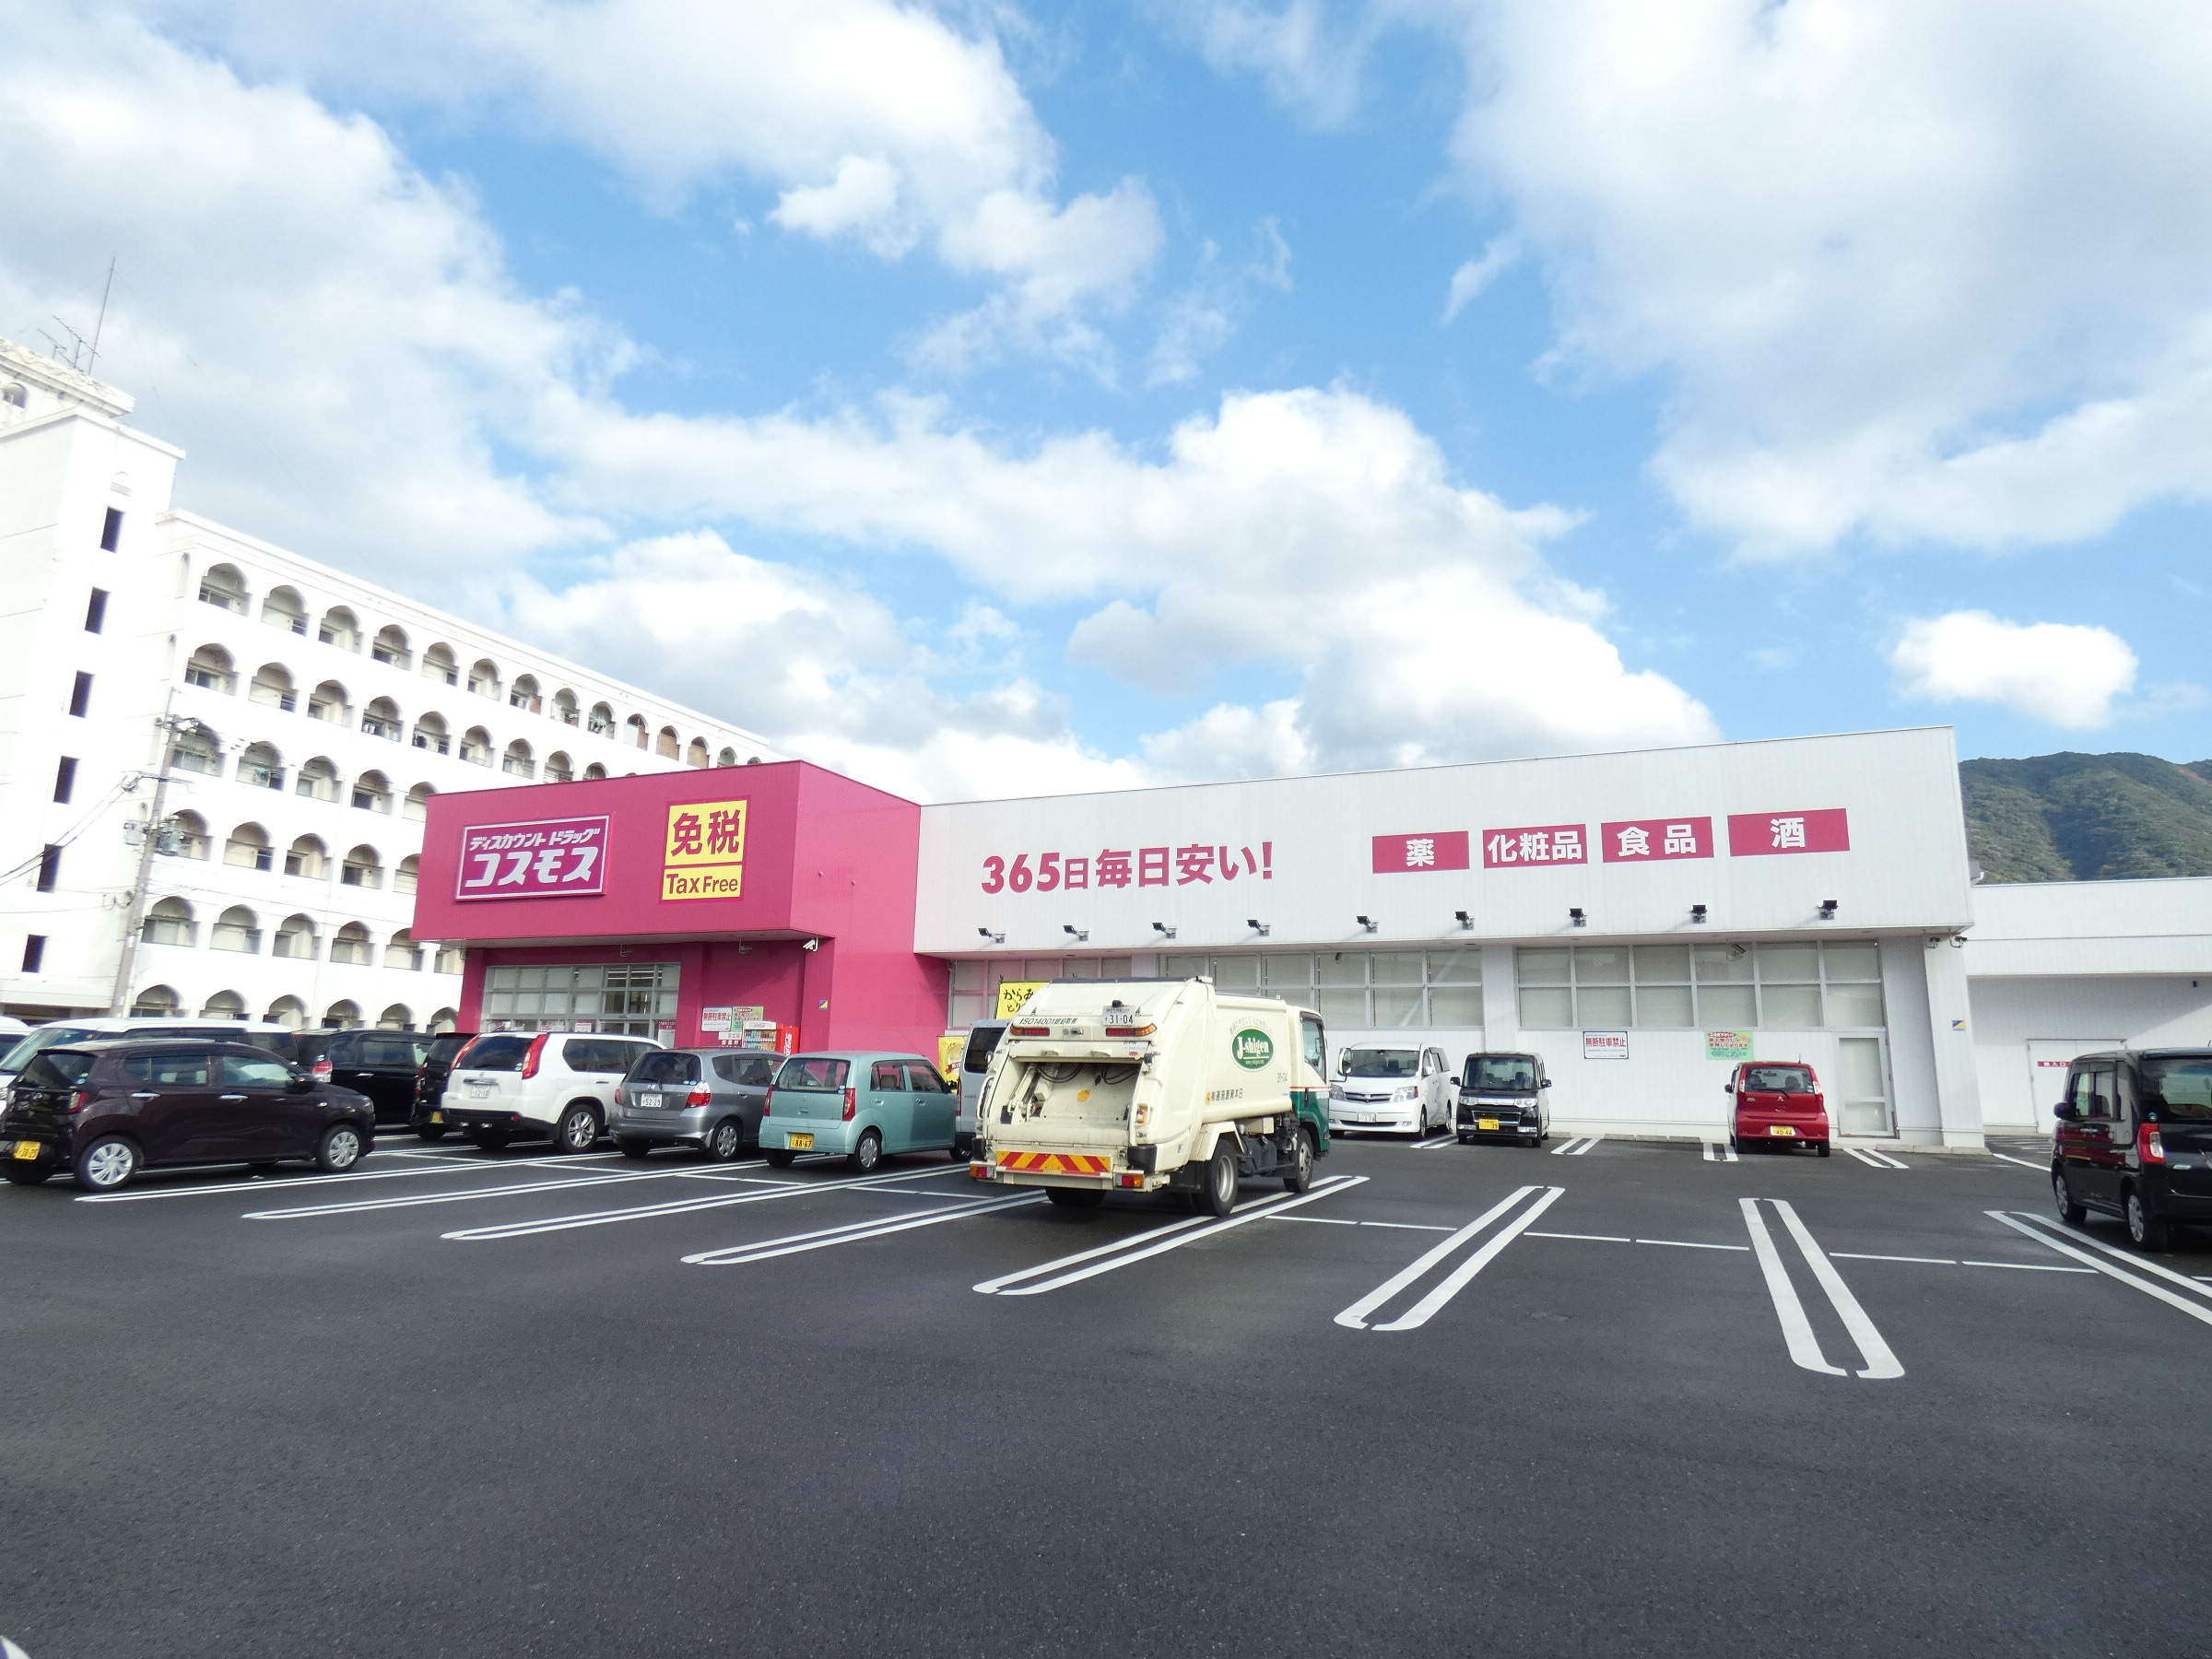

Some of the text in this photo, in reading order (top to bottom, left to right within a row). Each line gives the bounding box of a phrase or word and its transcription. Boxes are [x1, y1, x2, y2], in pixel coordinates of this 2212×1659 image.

[470, 829, 600, 851] ディスカウント ドラッグ
[671, 809, 740, 857] 免税
[1487, 831, 1582, 863] 化粧品
[1618, 823, 1697, 856] 食品
[1771, 818, 1806, 848] 酒
[465, 846, 598, 888] コスモス
[1406, 839, 1434, 867] 薬
[666, 874, 737, 894] Tax Free
[1237, 1037, 1269, 1059] J-shigen
[1585, 1037, 1626, 1047] 無断駐車禁止
